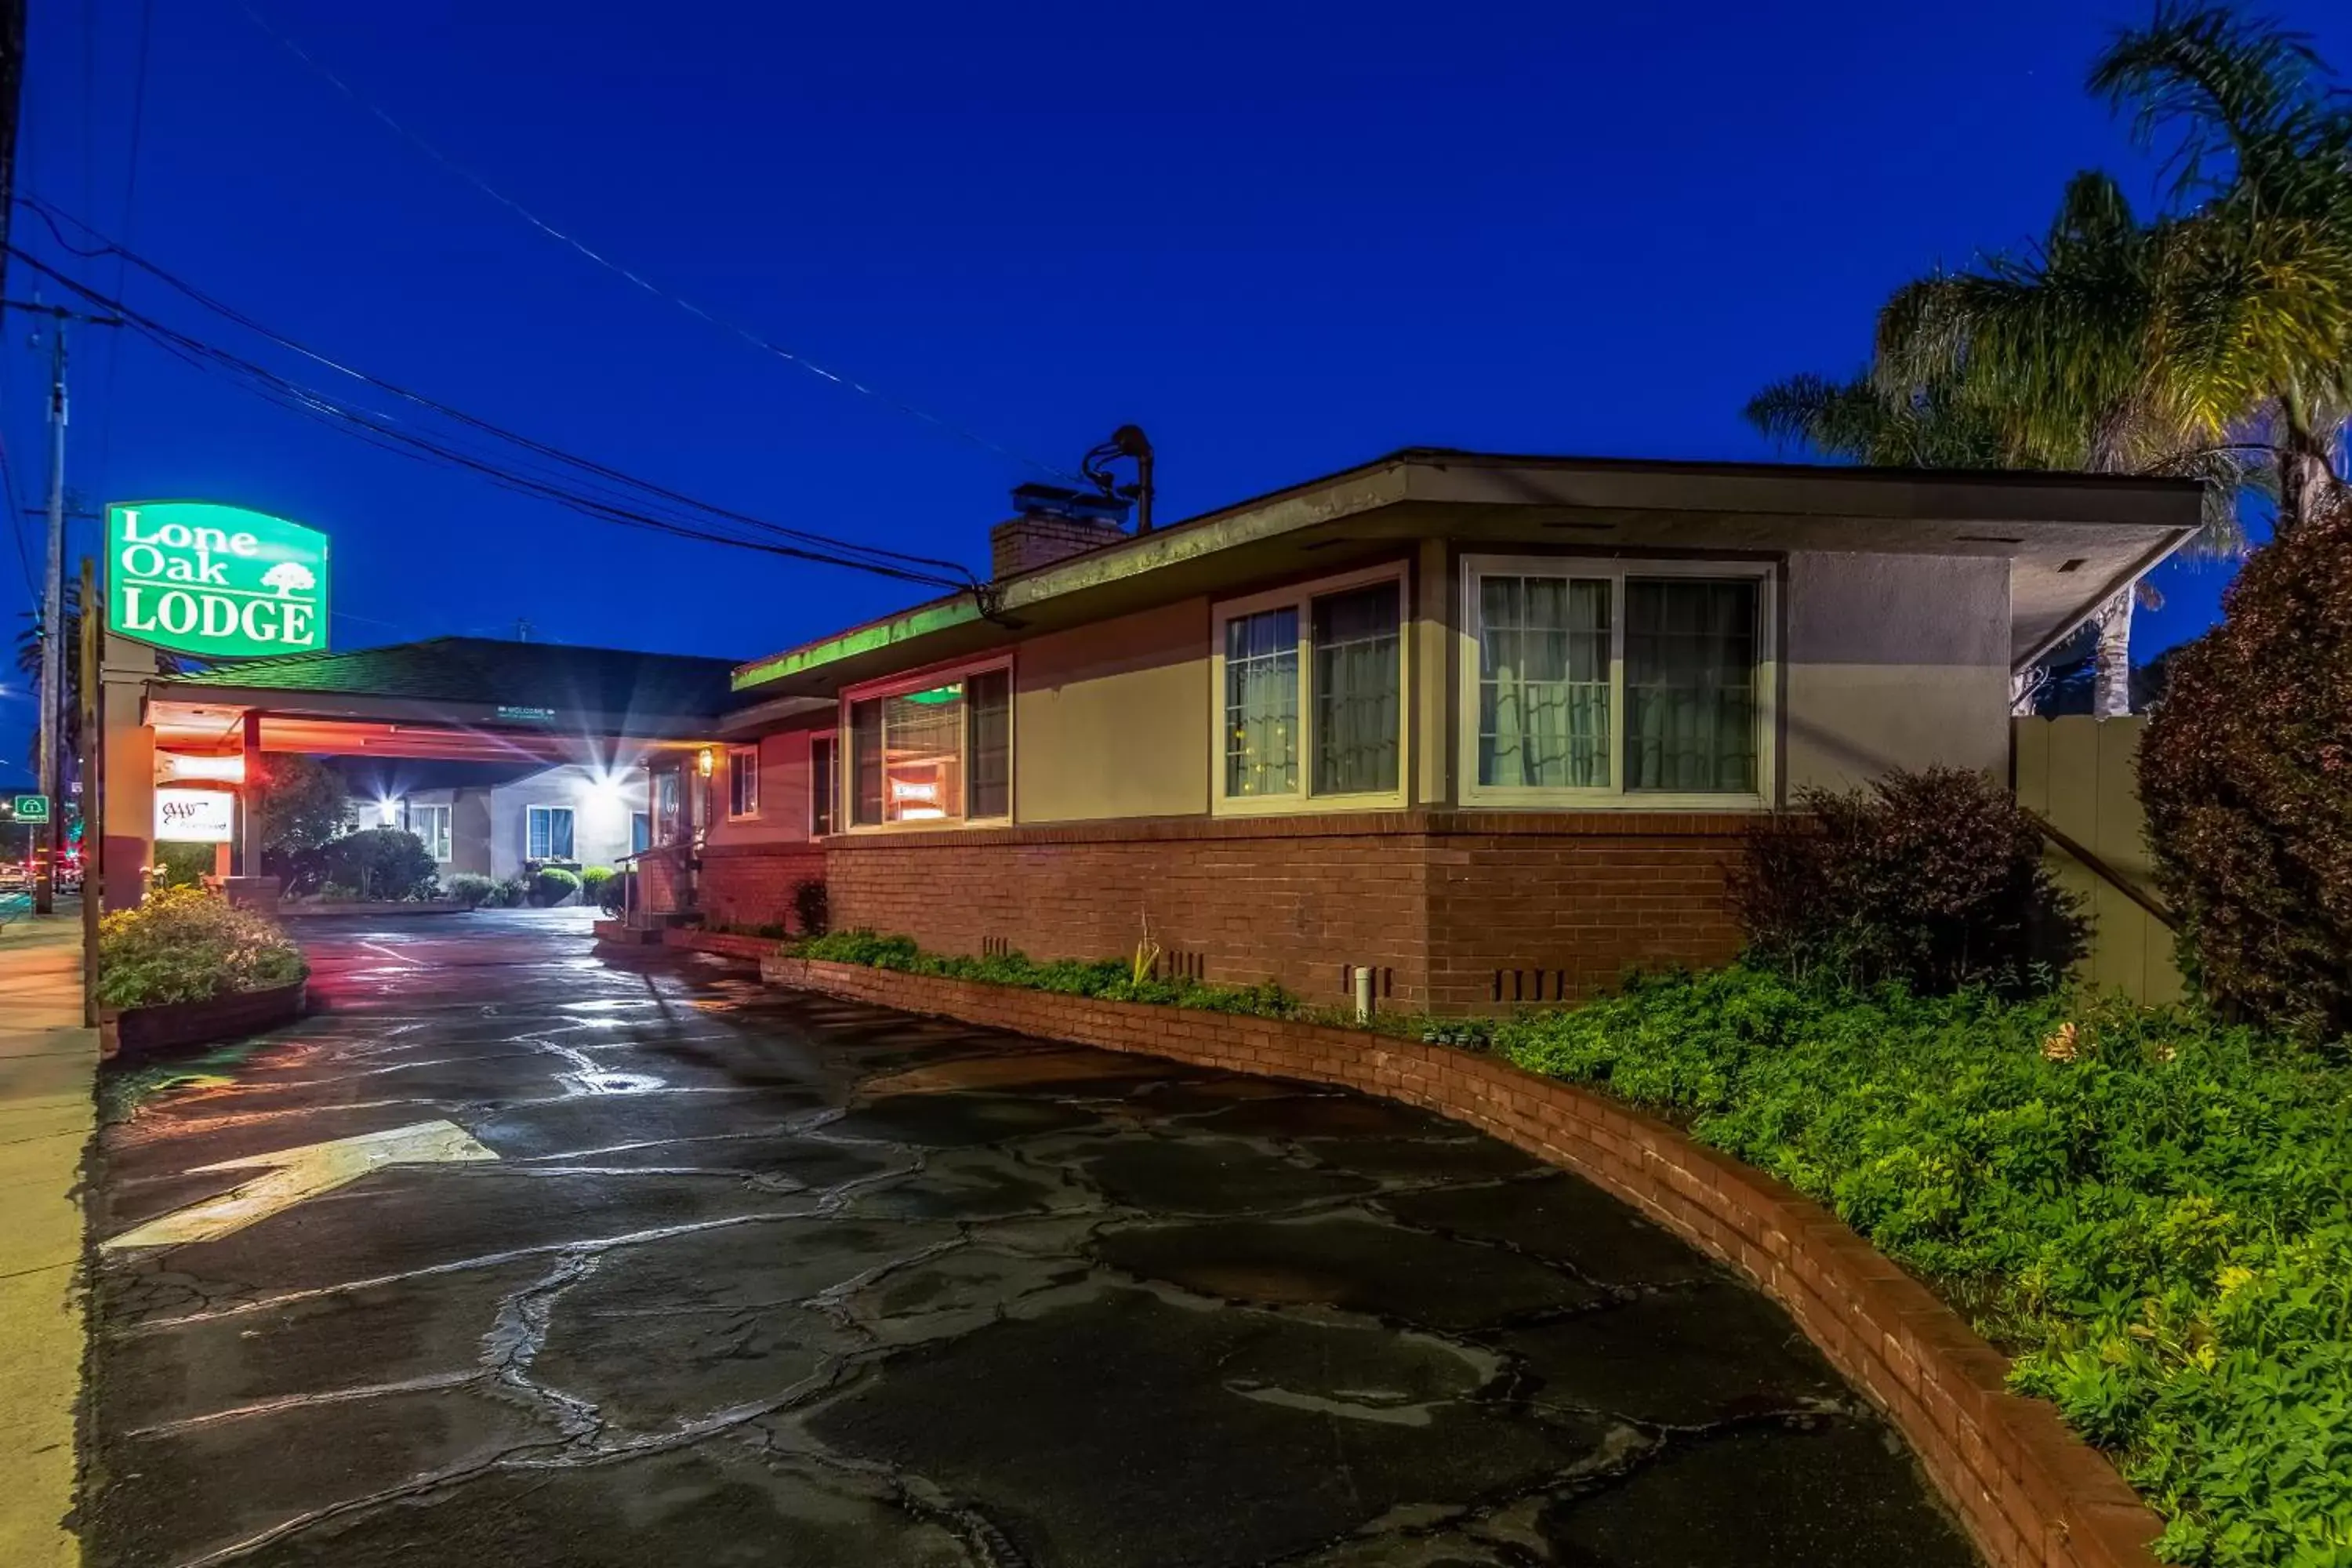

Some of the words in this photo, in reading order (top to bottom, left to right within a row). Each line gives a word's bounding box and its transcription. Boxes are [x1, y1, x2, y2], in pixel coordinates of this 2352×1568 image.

[121, 509, 259, 557] Lone
[122, 543, 230, 586] Oak
[122, 586, 314, 645] LODGE
